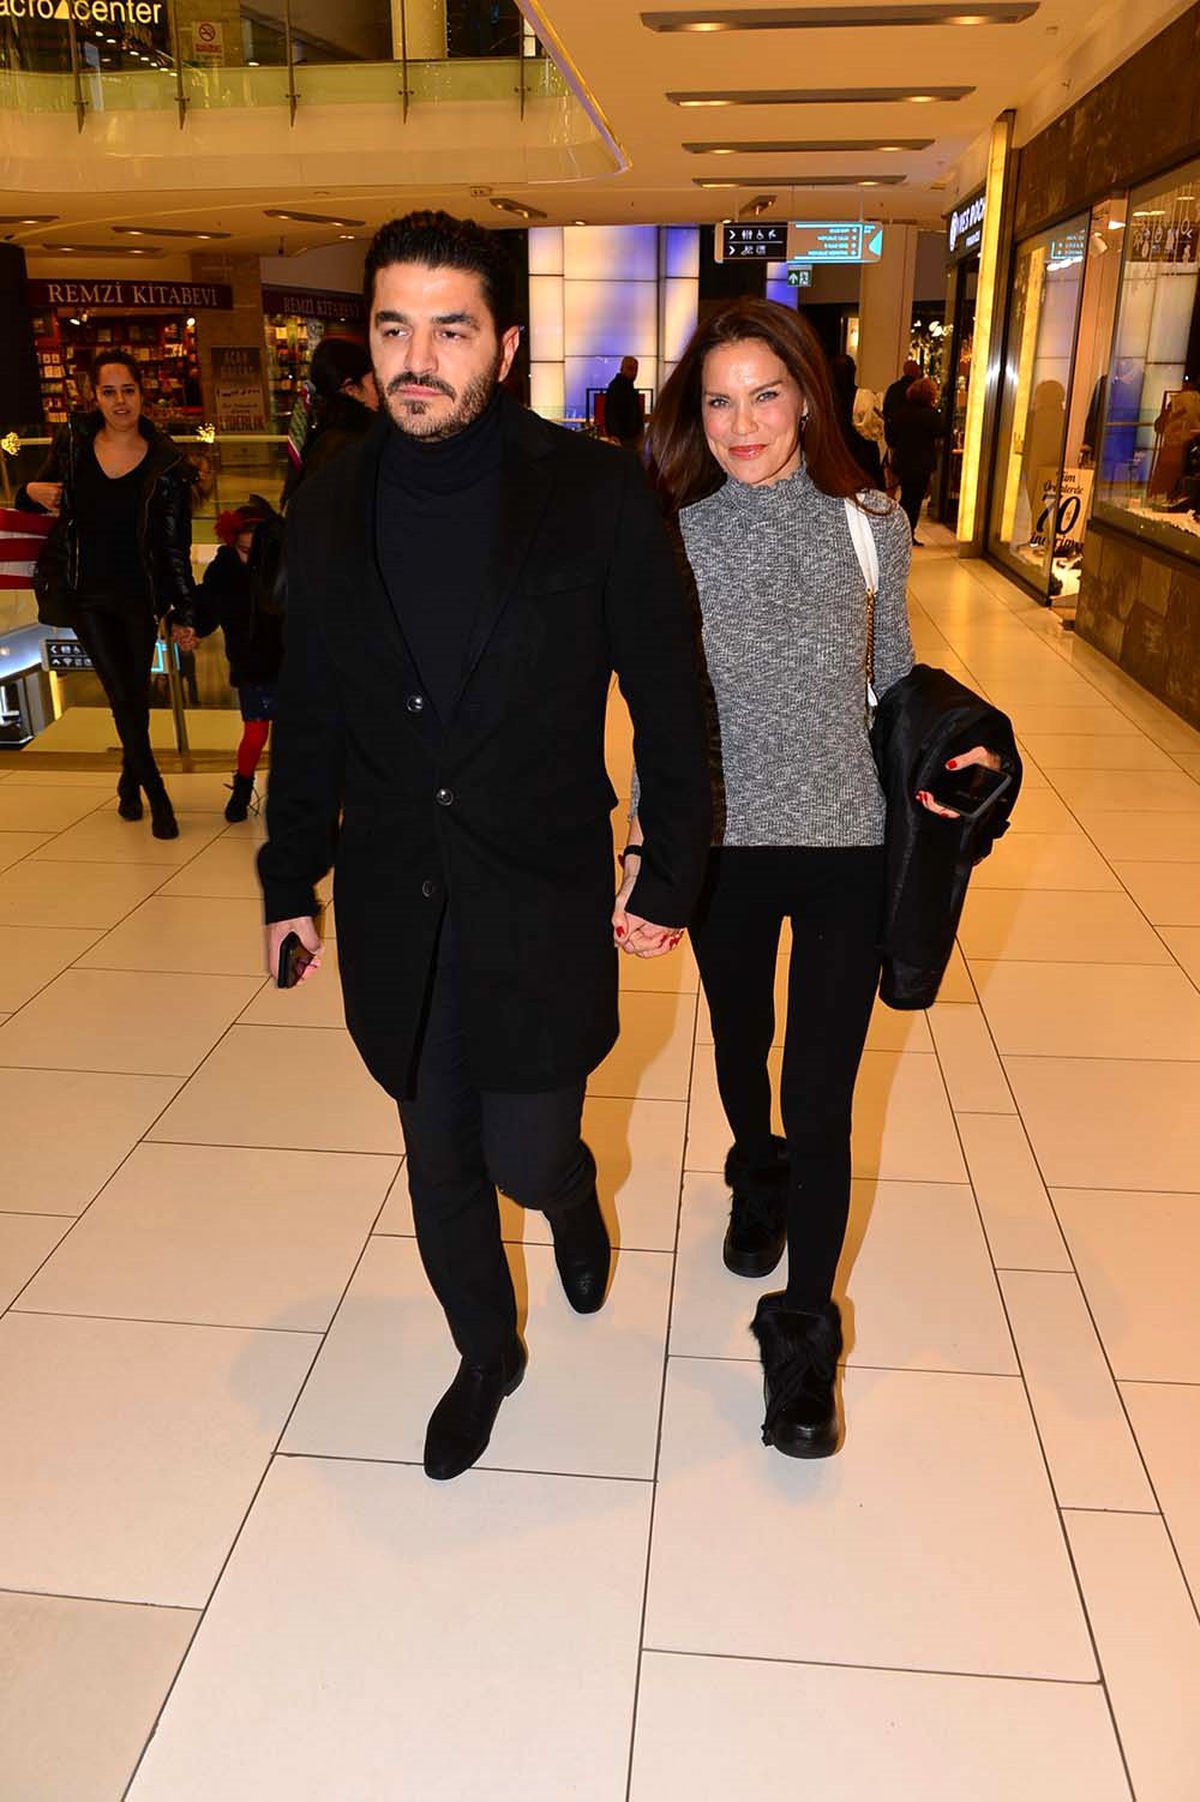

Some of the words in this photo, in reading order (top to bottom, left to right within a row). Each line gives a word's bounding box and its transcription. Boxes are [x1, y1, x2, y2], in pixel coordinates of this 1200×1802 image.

[74, 0, 162, 24] center
[48, 282, 125, 304] REMZİ
[1036, 495, 1081, 535] 70
